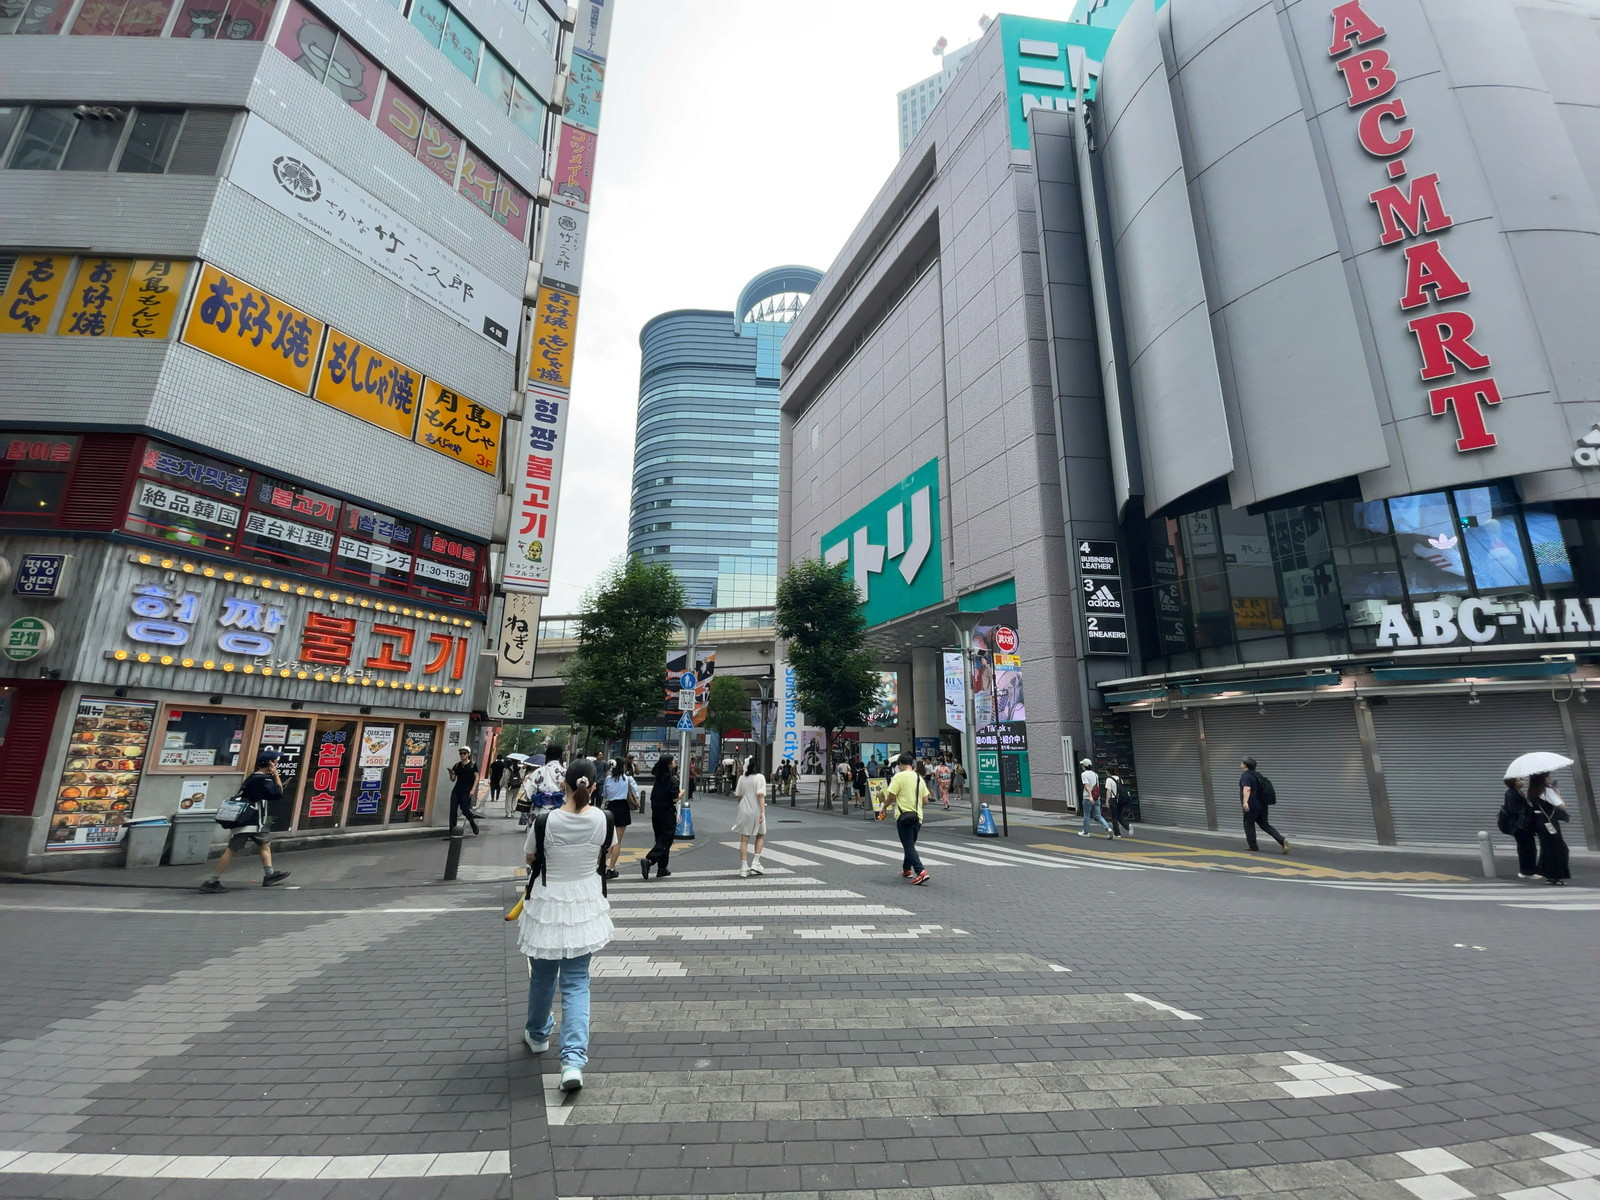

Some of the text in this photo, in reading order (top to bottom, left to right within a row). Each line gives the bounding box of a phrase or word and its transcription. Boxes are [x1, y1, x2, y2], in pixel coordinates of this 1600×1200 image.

[1018, 37, 1102, 91] ニト
[388, 97, 521, 219] コツメイト
[567, 129, 586, 189] コツメイト
[296, 211, 471, 323] SASHIMI SUSHI TEMPURA Japanese Restaurant
[555, 232, 574, 272] 竹二久郎
[8, 257, 55, 333] もんじゃ
[68, 260, 117, 337] お好焼
[131, 260, 172, 338] 月島もんじゃ
[199, 275, 313, 369] お好焼
[327, 340, 414, 415] もんじゃ焼
[434, 388, 491, 430] 月島
[423, 408, 496, 450] もんじゃ
[6, 439, 72, 462] 참이슬
[475, 453, 494, 469] 3F
[518, 398, 559, 539] 형짱 불고기
[155, 451, 249, 496] 포차맛집
[141, 486, 239, 527] 絶品韓国
[271, 486, 335, 522] 불고기
[339, 539, 411, 569] 平日ランチ
[432, 536, 476, 563] 참이슬
[1079, 541, 1091, 554] 4
[1081, 562, 1111, 570] LEATHER
[20, 575, 53, 591] 냉면
[24, 559, 59, 575] 평양
[1083, 579, 1095, 592] 3
[1087, 598, 1121, 608] adidas
[8, 631, 41, 647] 잡채
[126, 582, 468, 681] 형짱 불고기
[504, 613, 529, 665] ねぎし
[1087, 617, 1099, 630] 2
[1088, 630, 1126, 639] SNEAKERS
[77, 704, 104, 717] 메뉴
[497, 689, 511, 716] ねぎし
[782, 731, 799, 761] City
[986, 724, 1007, 733] Tikok
[308, 743, 346, 818] 참이슬
[981, 758, 996, 768] ニトリ
[397, 768, 424, 812] 고기
